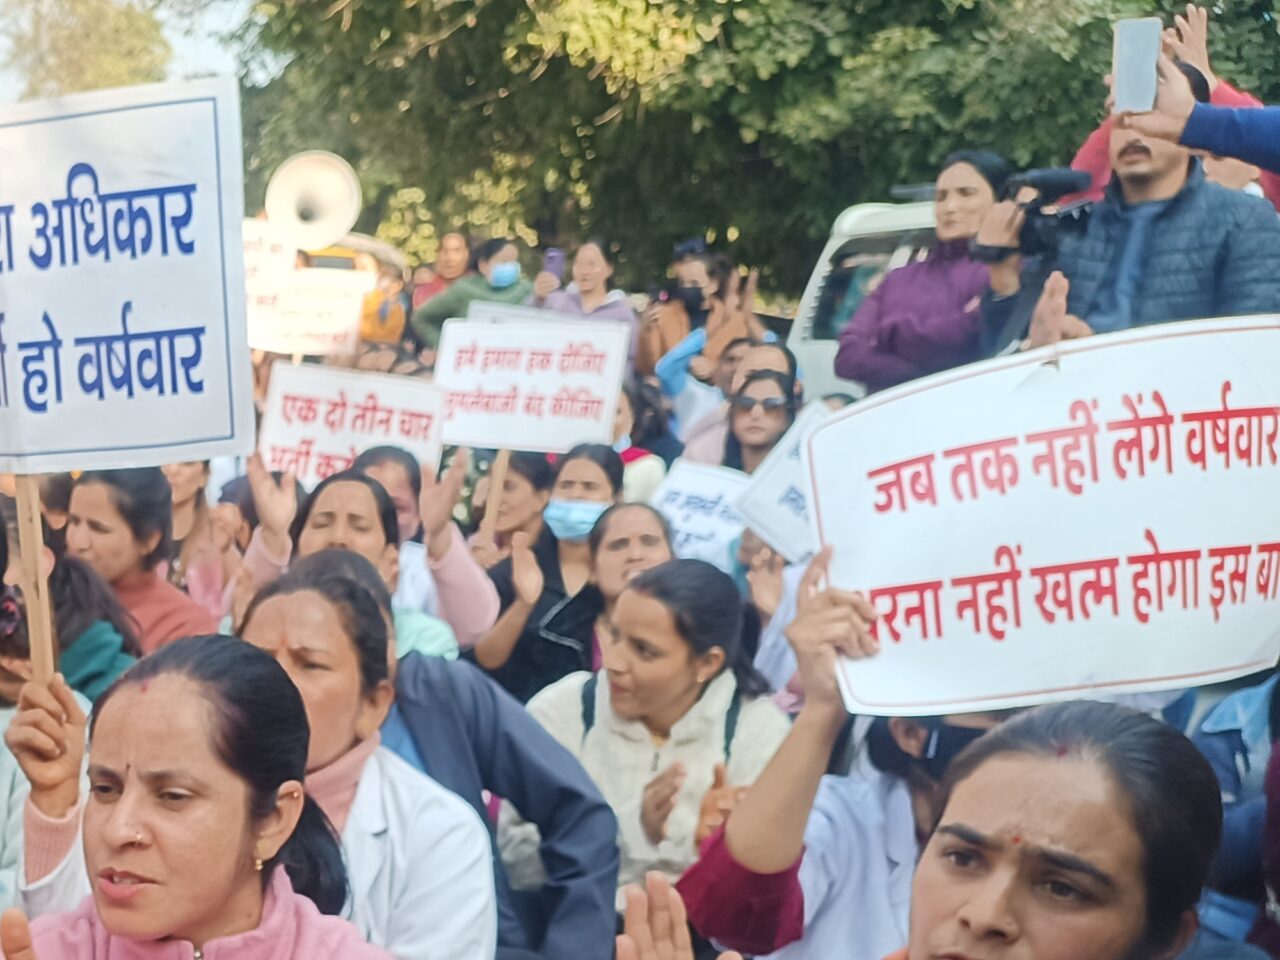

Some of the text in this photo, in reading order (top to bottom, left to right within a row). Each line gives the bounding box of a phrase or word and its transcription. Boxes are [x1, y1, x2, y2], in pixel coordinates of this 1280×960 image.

[29, 162, 197, 270] अधिकार
[18, 312, 64, 413] हो
[75, 302, 206, 400] वर्षवार
[282, 391, 435, 440] एक दो तीन चार
[867, 453, 937, 514] जब
[943, 437, 1018, 502] तक
[1025, 398, 1100, 495] नहीं
[1107, 390, 1174, 481] लेंगे
[1182, 380, 1280, 473] वर्षवार
[951, 543, 1022, 641] नहीं
[1030, 557, 1119, 624] खत्म
[1128, 527, 1201, 625] होगा
[1208, 545, 1251, 622] इस
